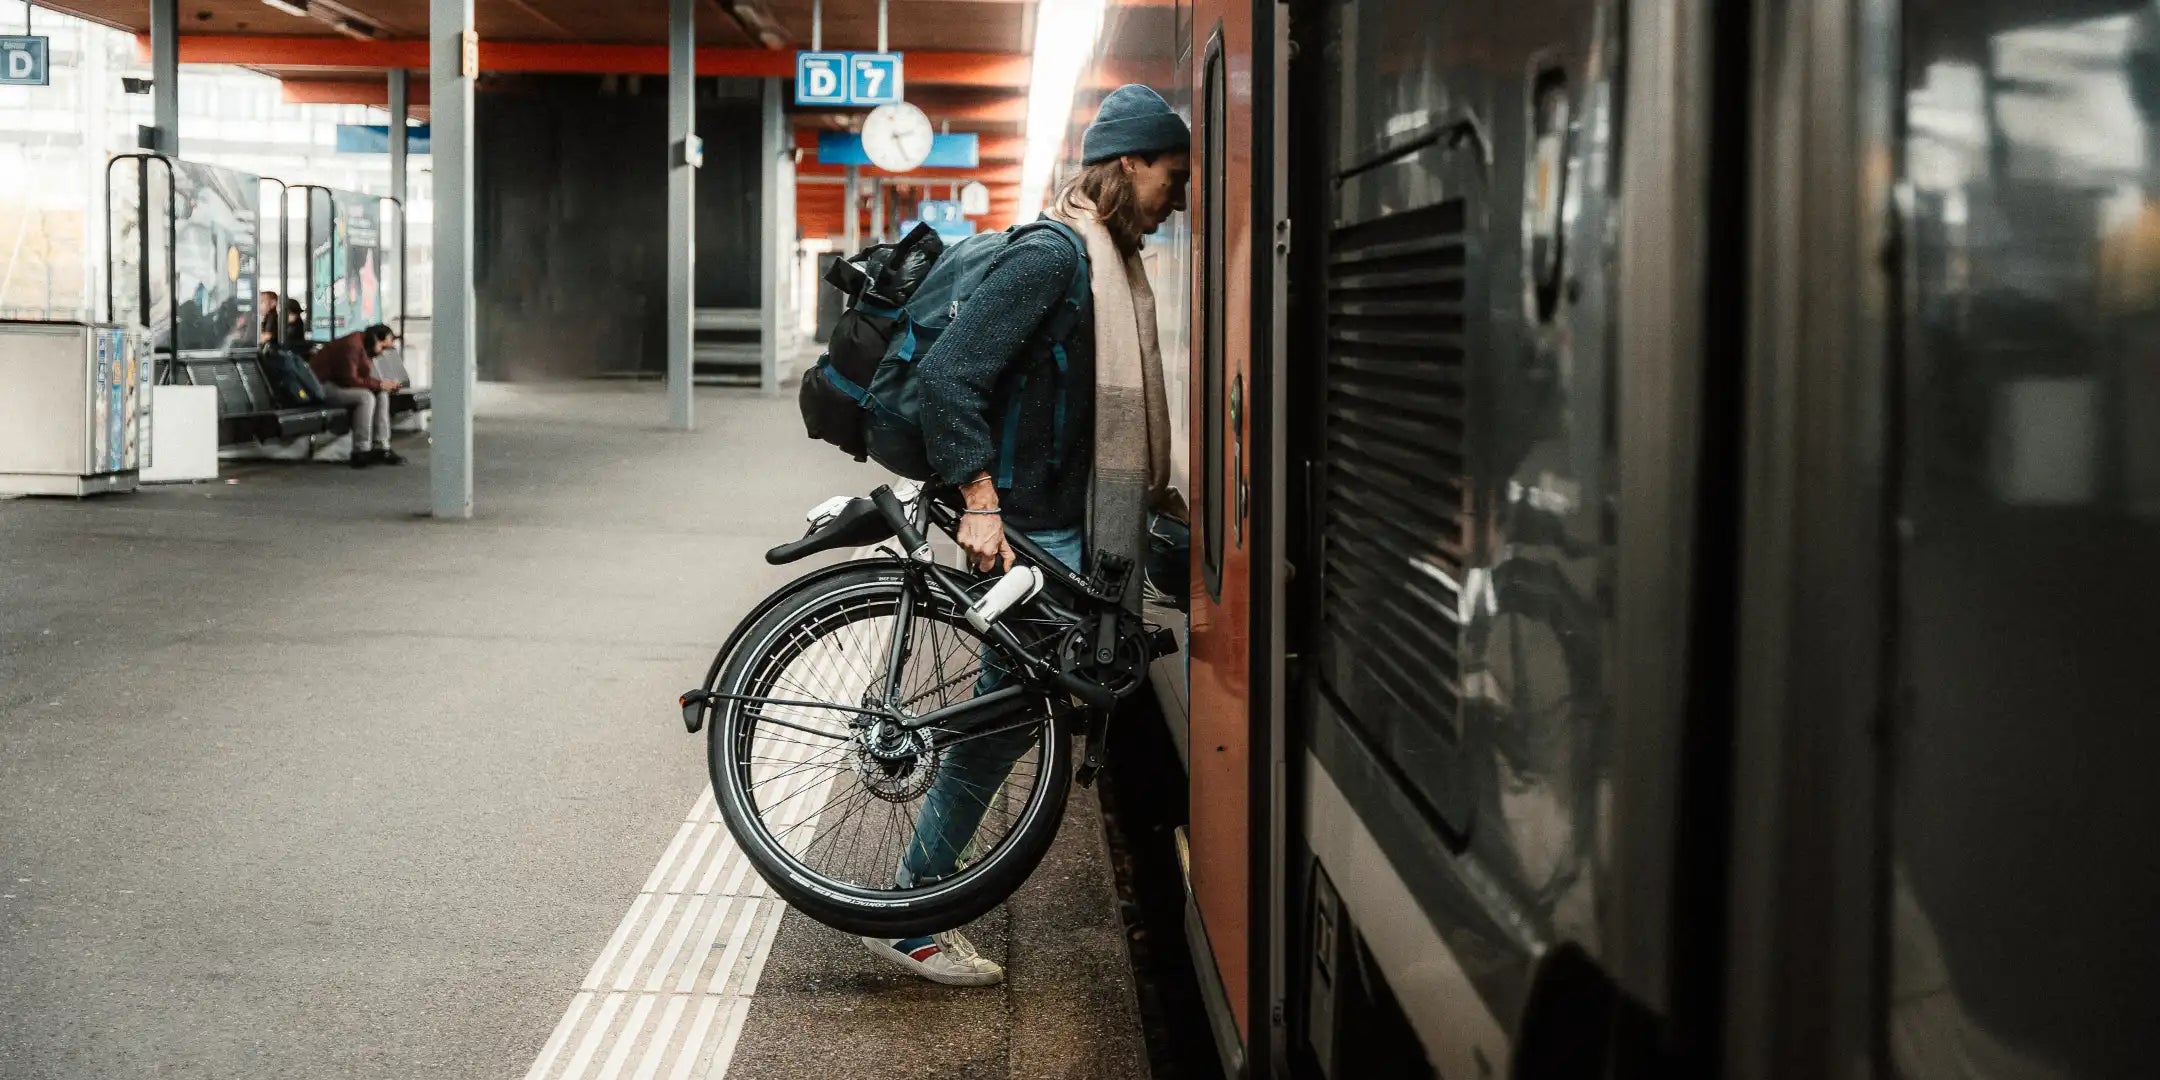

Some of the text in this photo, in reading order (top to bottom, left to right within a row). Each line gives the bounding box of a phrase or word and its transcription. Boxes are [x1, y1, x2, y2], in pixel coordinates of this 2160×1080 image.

[9, 49, 33, 79] D
[810, 67, 886, 97] D 7
